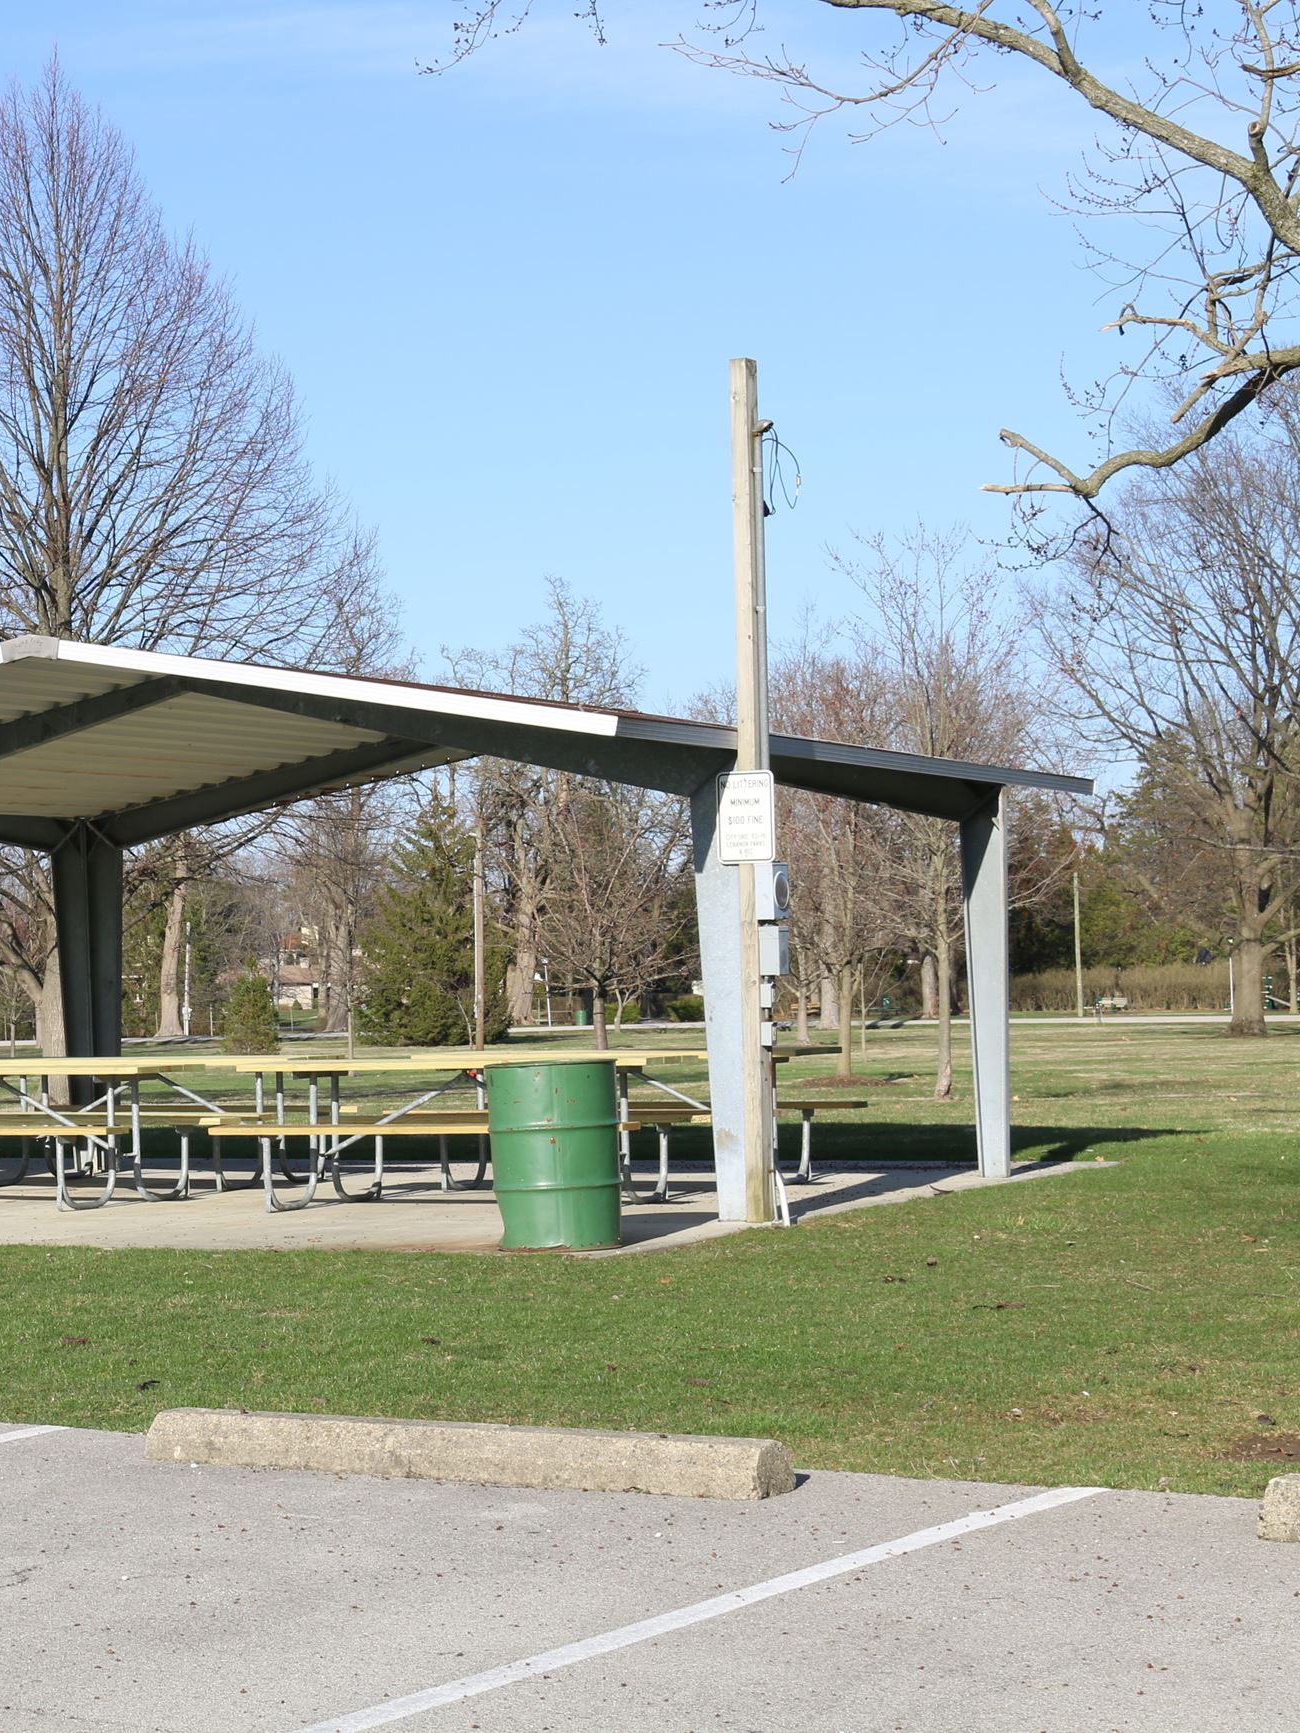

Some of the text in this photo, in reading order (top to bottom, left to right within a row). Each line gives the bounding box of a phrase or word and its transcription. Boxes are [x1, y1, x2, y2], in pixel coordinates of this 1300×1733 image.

[720, 778, 769, 789] NO LITTERING
[730, 798, 760, 806] MINIMUM
[728, 815, 763, 825] $100 FINE
